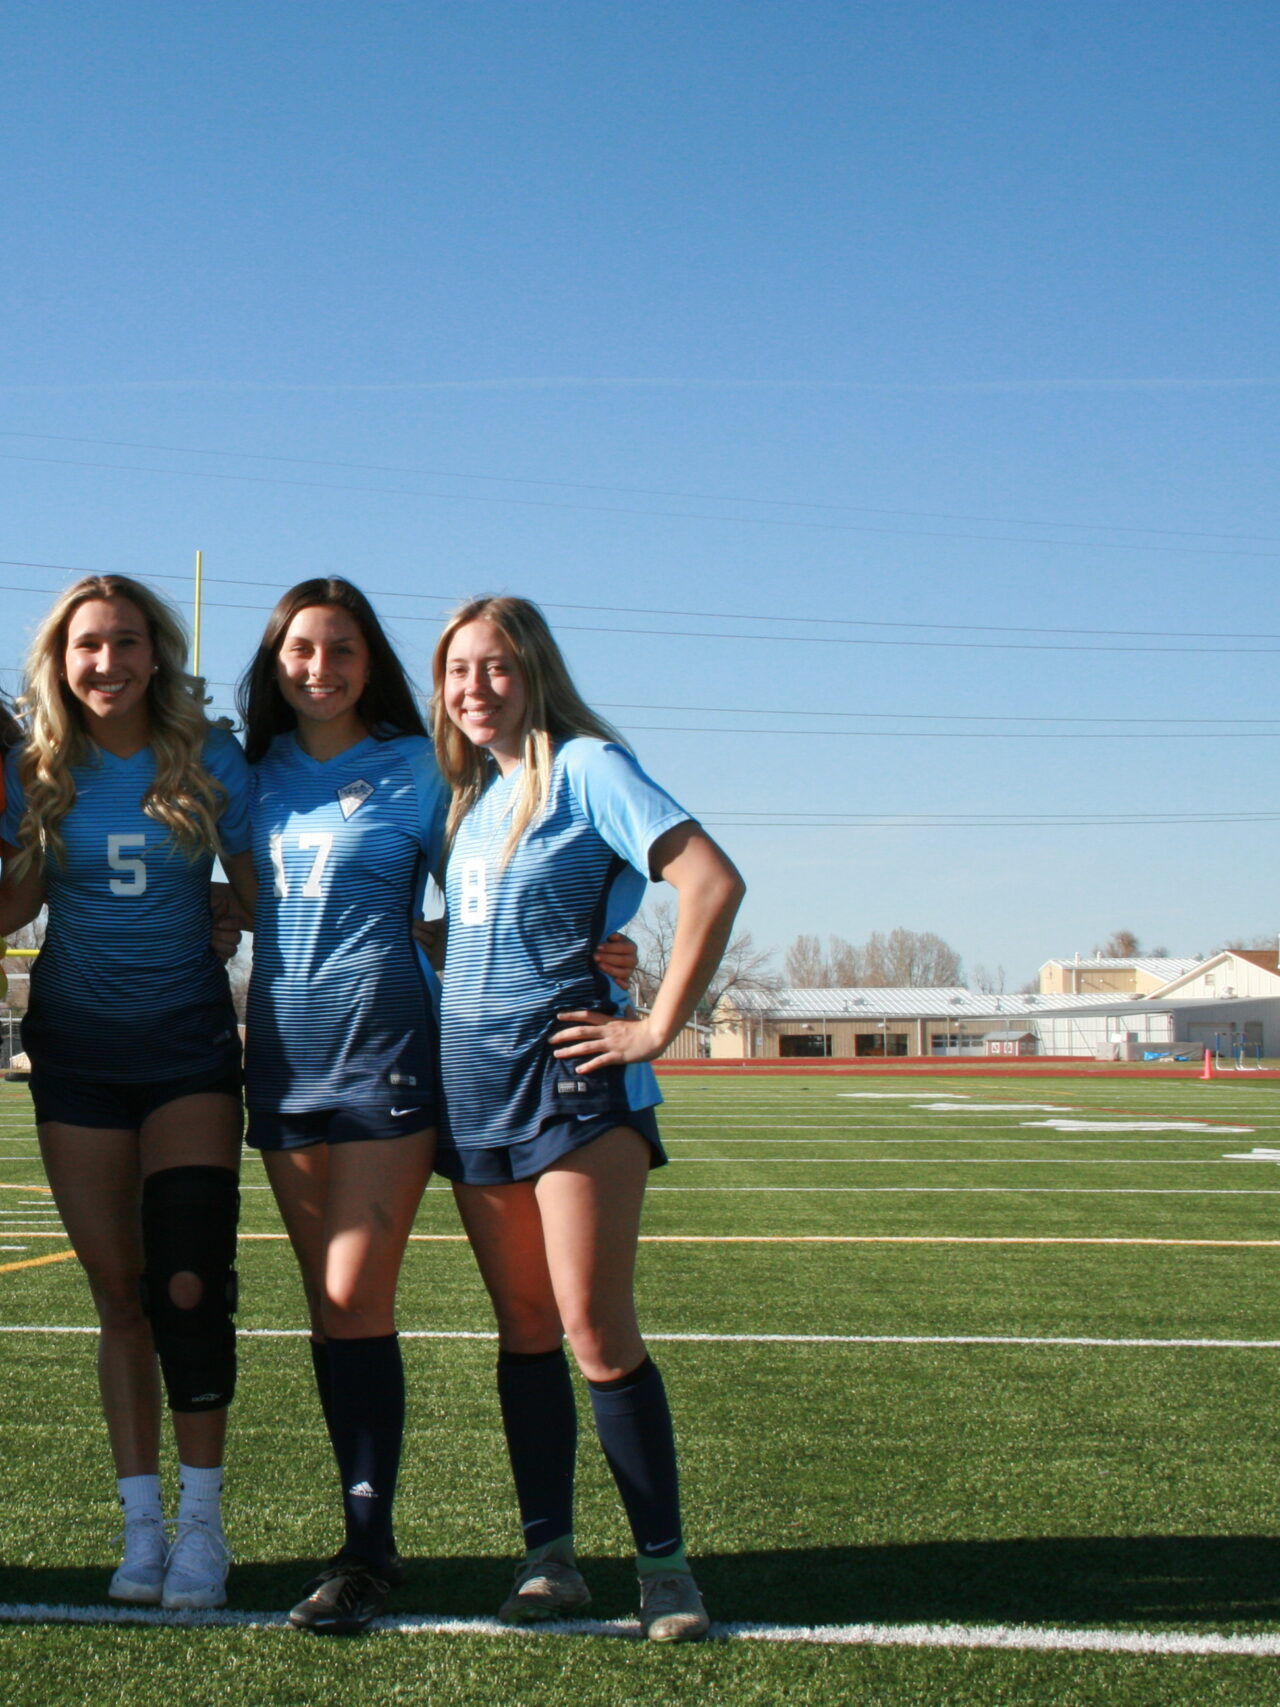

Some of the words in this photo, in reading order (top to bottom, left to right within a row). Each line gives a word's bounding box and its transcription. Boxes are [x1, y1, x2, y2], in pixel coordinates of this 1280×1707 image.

[107, 834, 147, 895] 5
[269, 832, 333, 897] 17
[461, 859, 487, 925] 8
